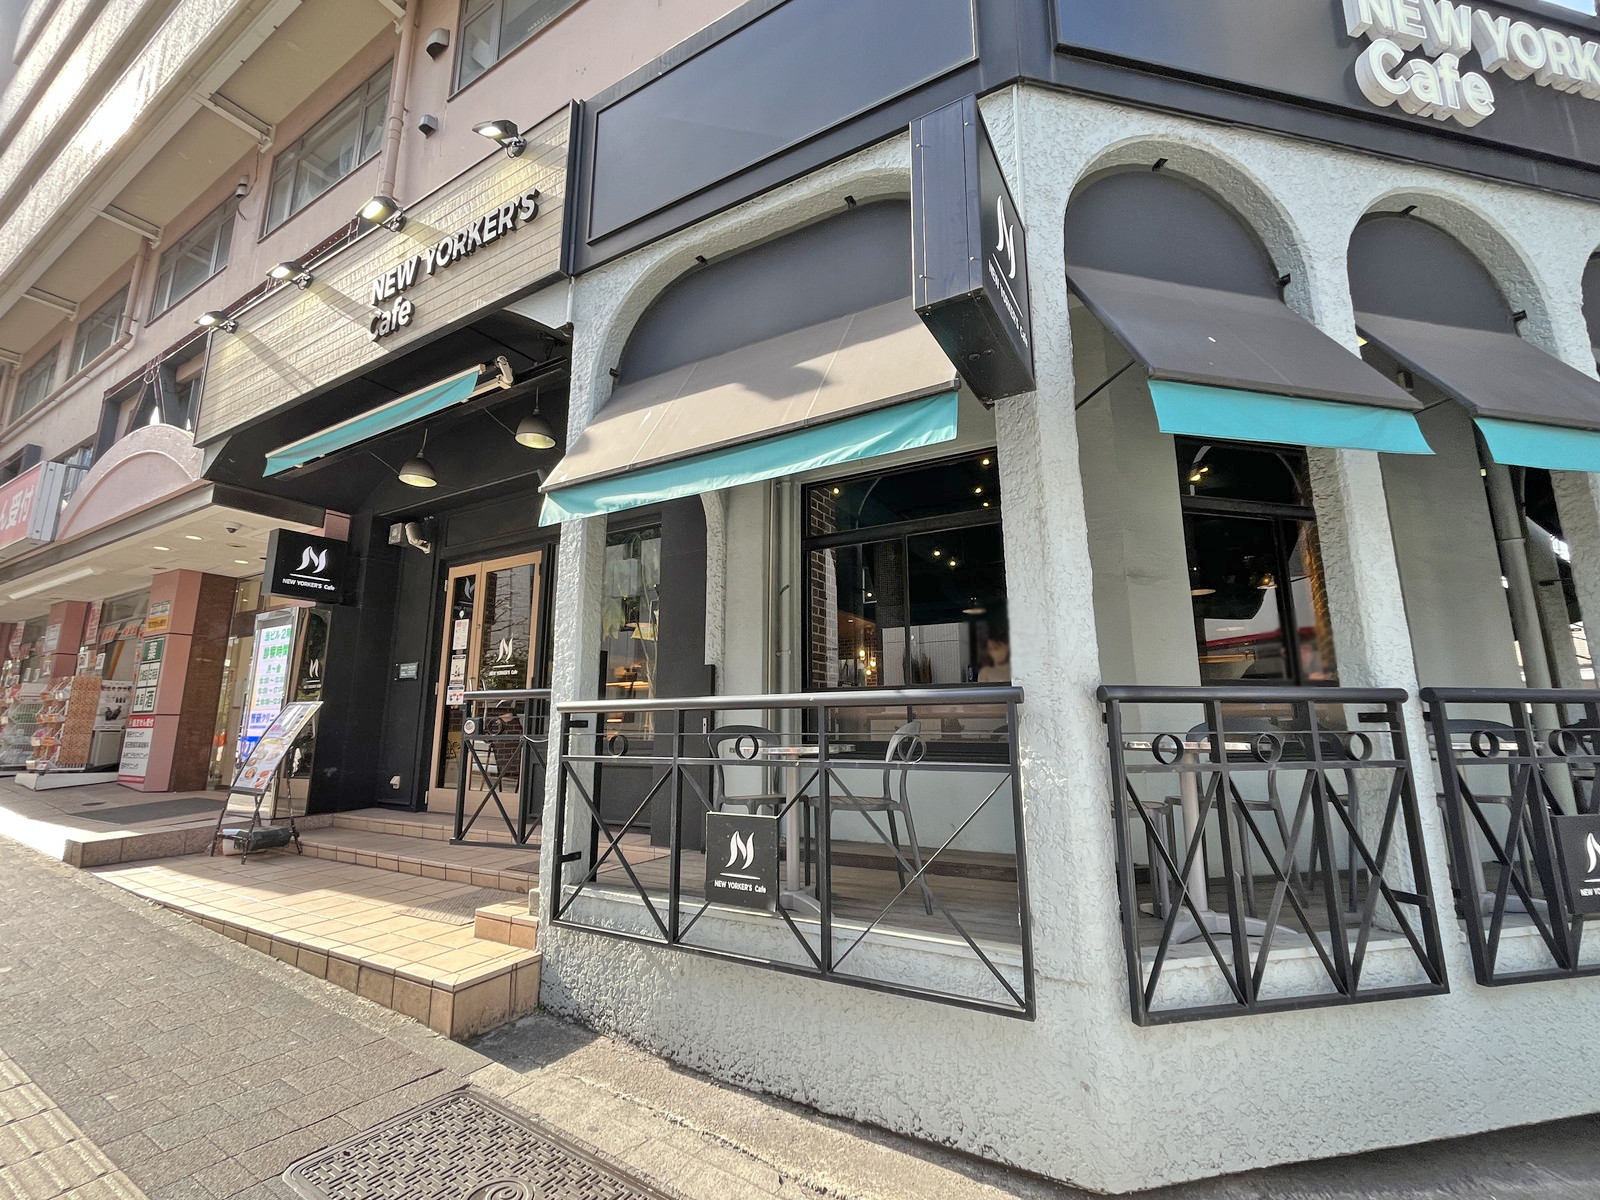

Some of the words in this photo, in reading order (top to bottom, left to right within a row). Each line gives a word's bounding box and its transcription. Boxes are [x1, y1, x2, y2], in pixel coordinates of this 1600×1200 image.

[1342, 0, 1471, 58] NEW
[1354, 38, 1495, 128] Cafe
[371, 254, 421, 306] NEW
[427, 188, 540, 275] YORKER'S
[369, 297, 415, 342] Cafe
[282, 578, 297, 586] NEW
[296, 580, 323, 590] YORKER'S
[714, 879, 727, 888] NEW
[728, 881, 752, 892] YORKER'S
[754, 885, 767, 894] Cafe
